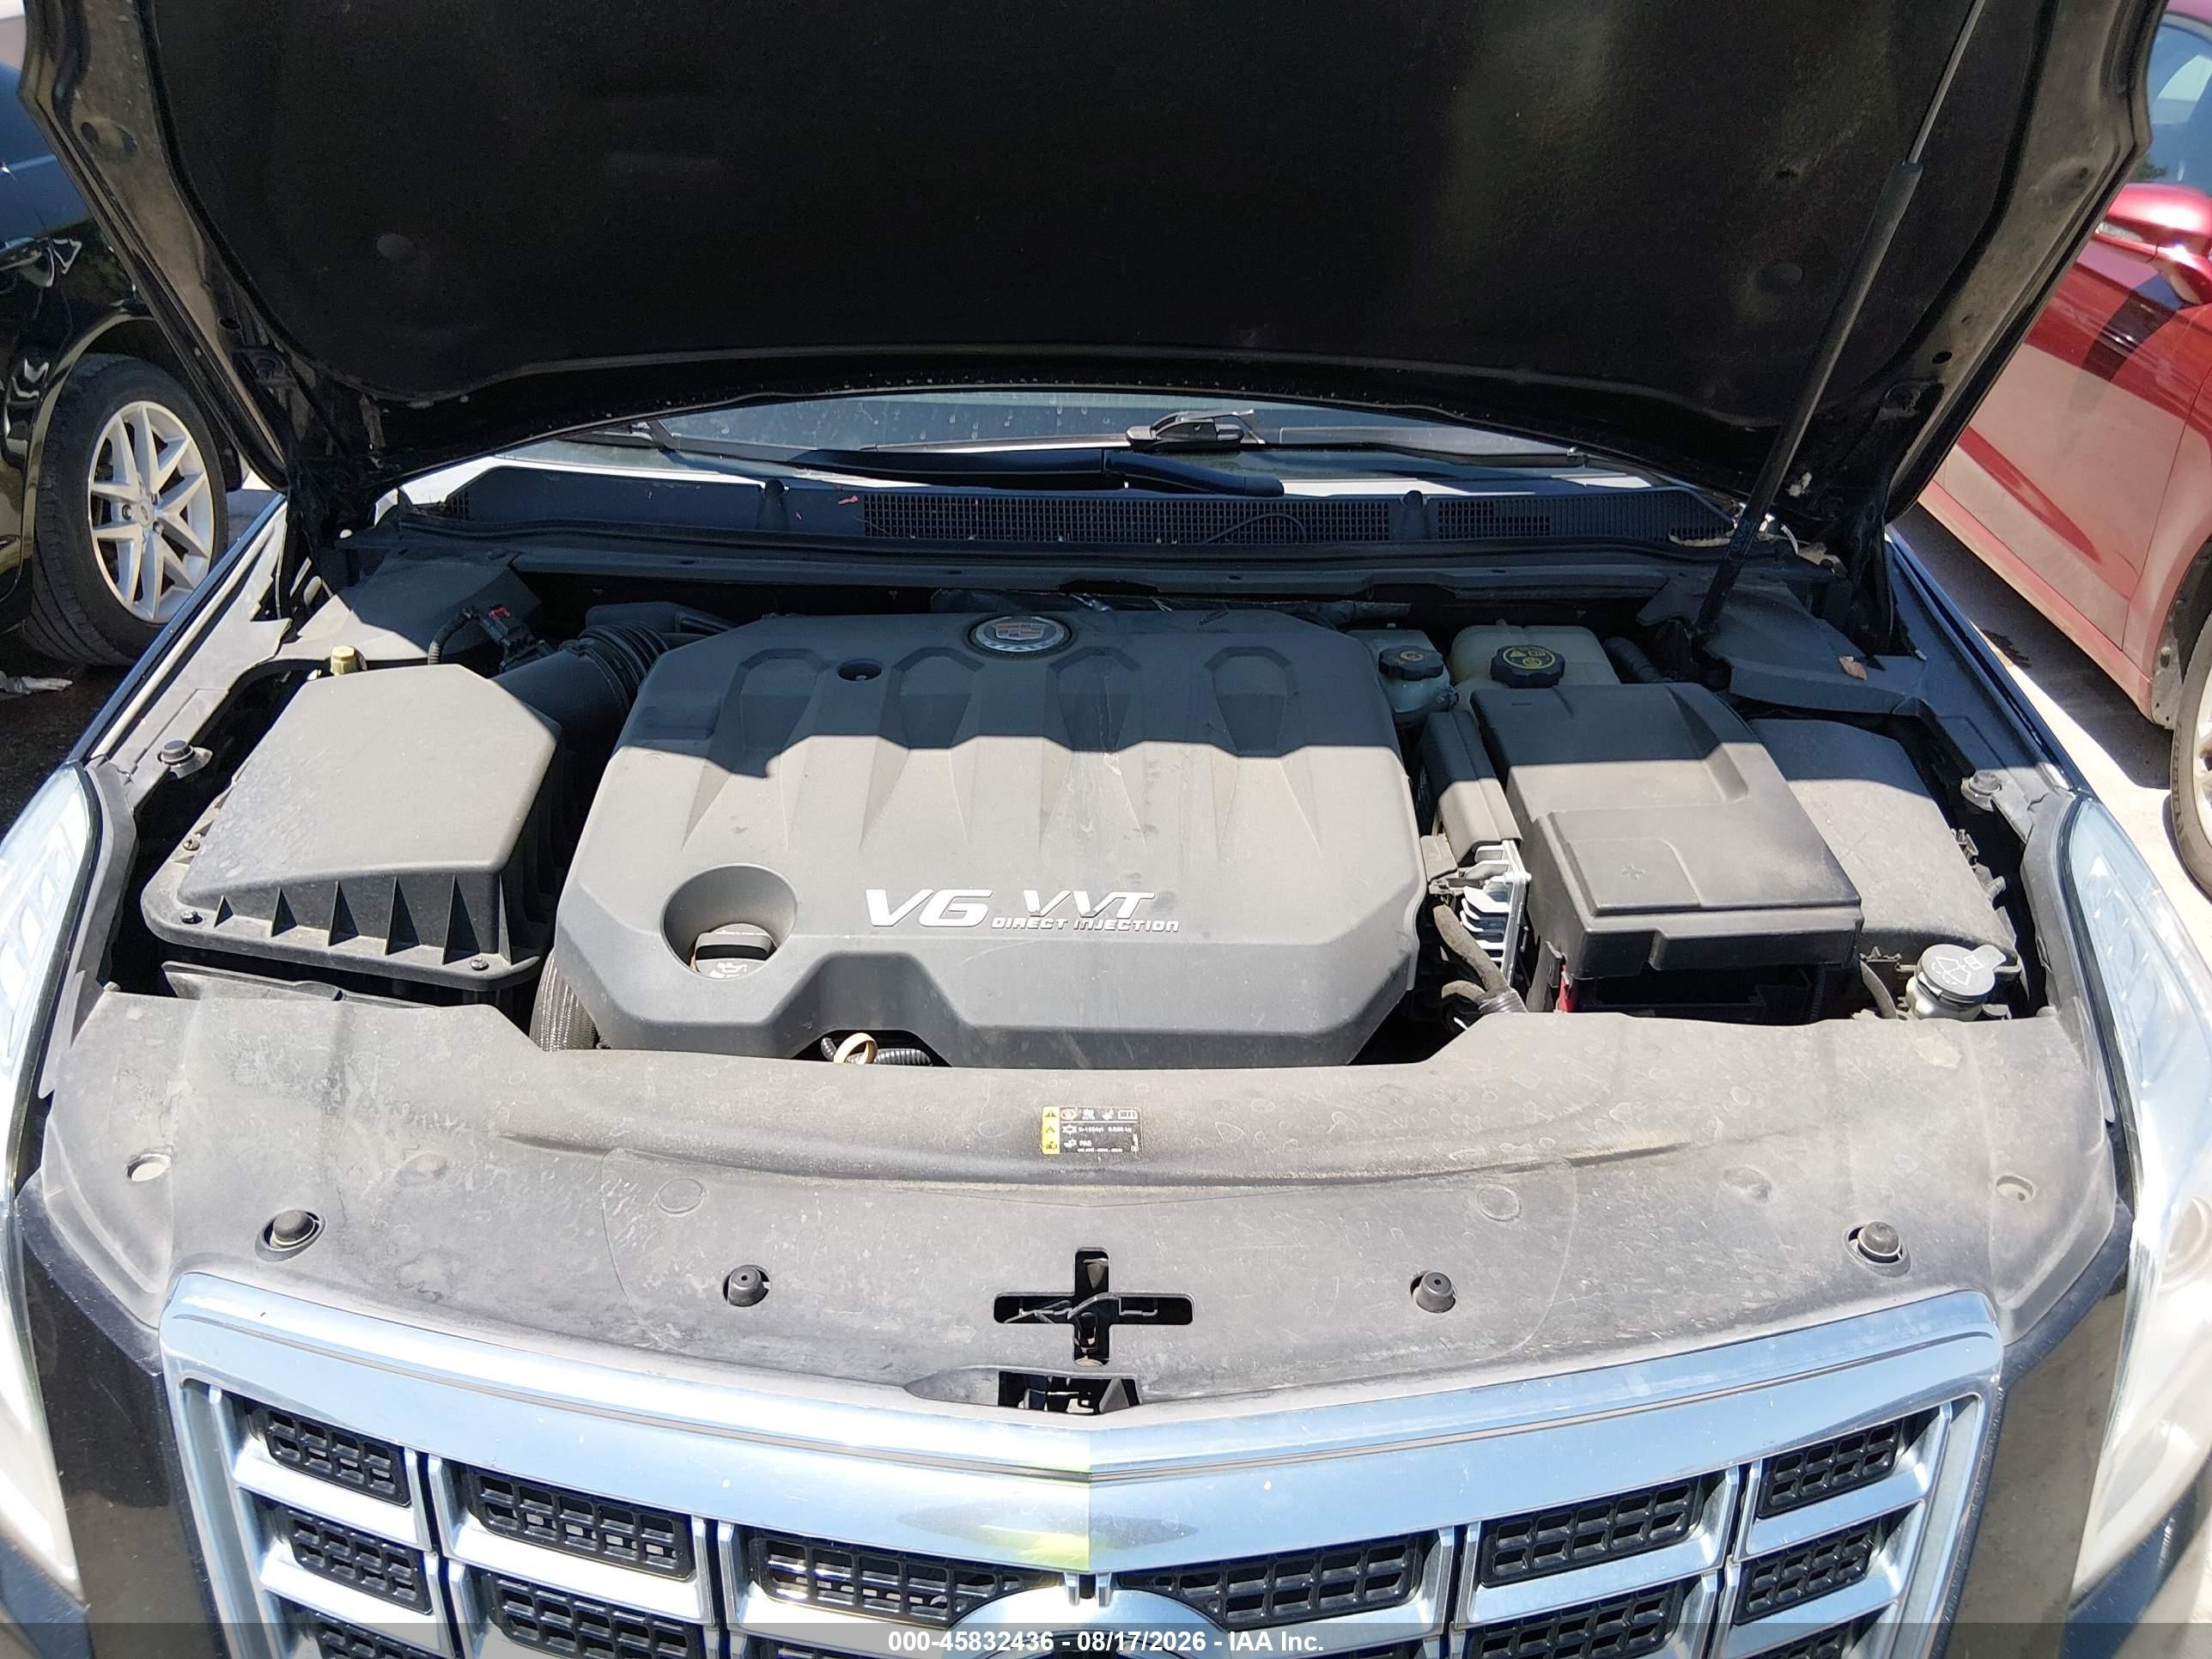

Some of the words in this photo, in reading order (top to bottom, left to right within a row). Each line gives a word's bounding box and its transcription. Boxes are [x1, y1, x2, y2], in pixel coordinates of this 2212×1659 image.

[866, 889, 994, 927] V6
[1023, 890, 1156, 919] VVT
[991, 916, 1068, 931] DIRECT
[1073, 917, 1180, 933] INJECTION
